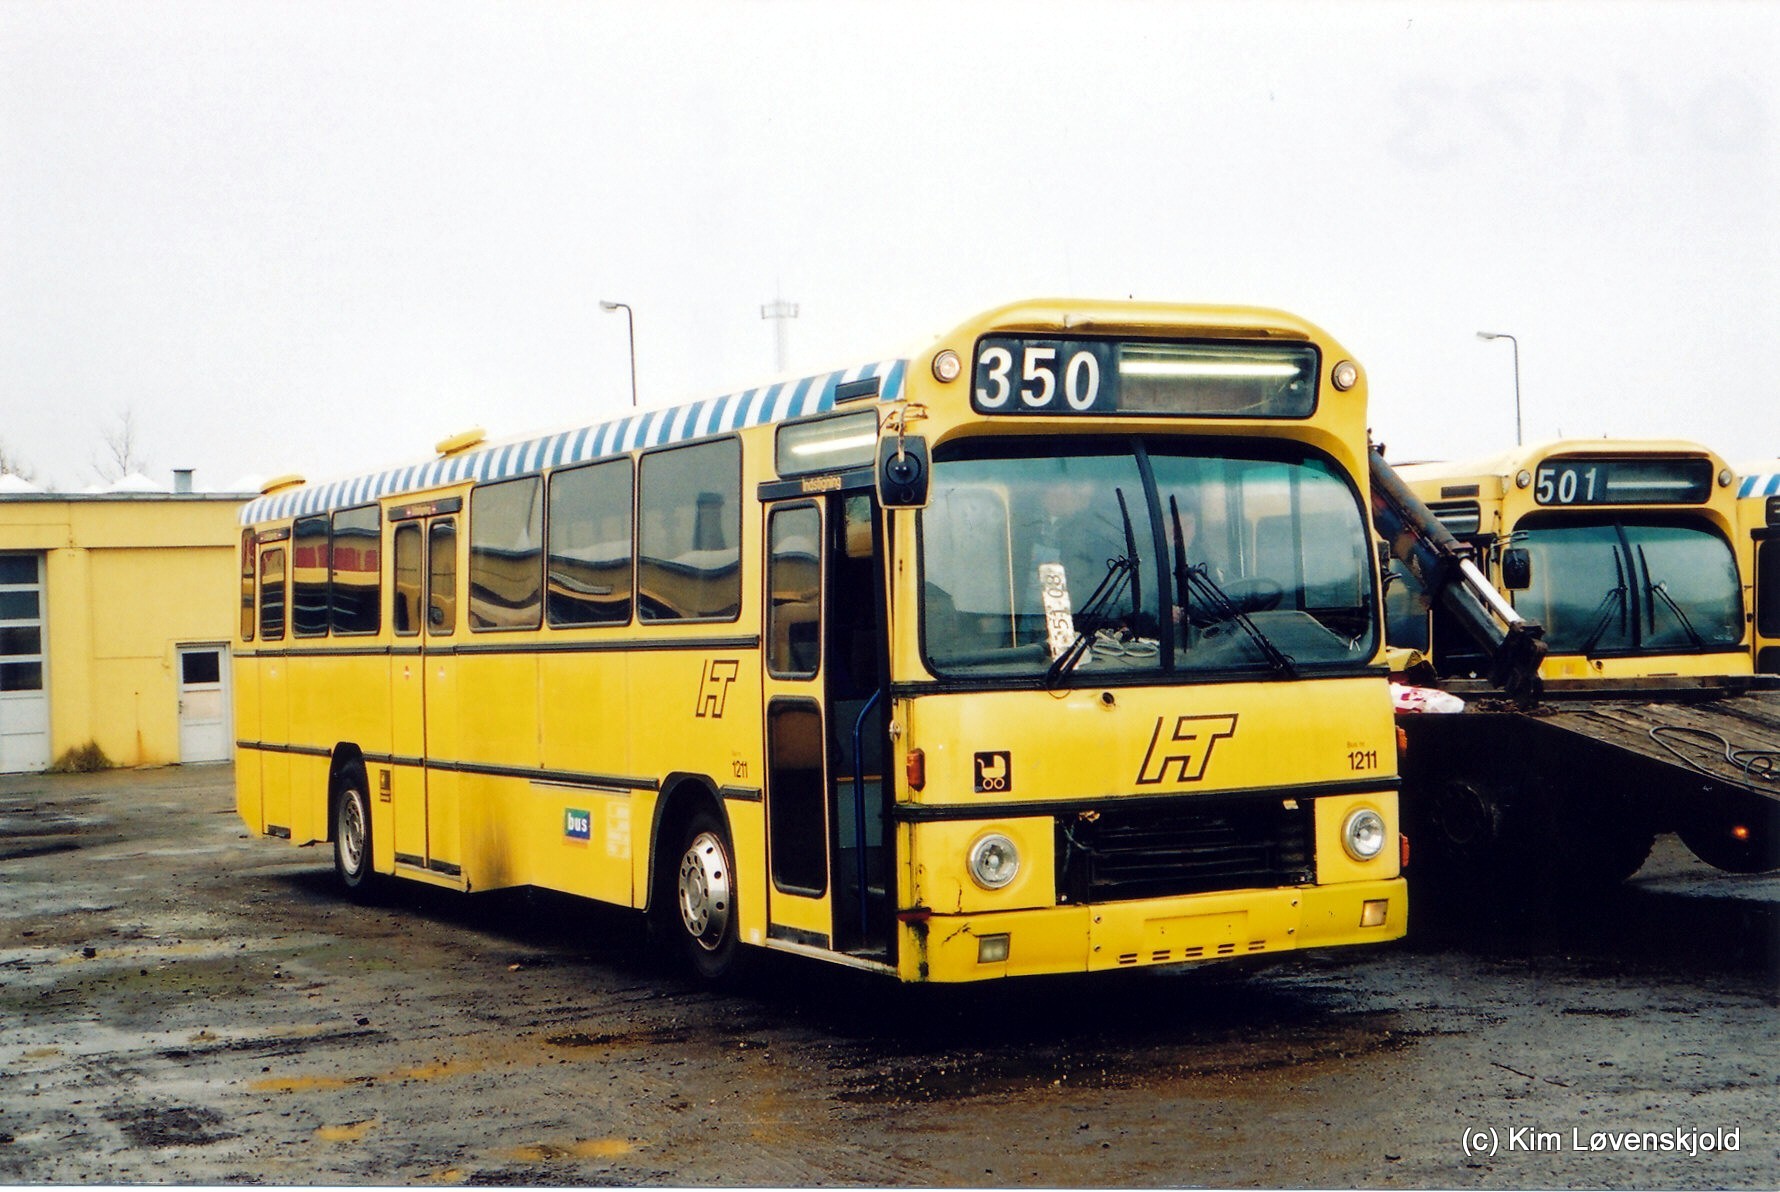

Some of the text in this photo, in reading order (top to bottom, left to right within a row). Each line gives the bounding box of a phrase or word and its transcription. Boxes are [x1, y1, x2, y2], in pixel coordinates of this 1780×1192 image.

[976, 347, 1099, 410] 350
[1537, 467, 1596, 503] 501
[696, 659, 739, 718] HT
[1136, 713, 1239, 785] HT
[1347, 750, 1377, 770] 1211
[732, 761, 748, 778] 1211
[567, 812, 588, 832] bus
